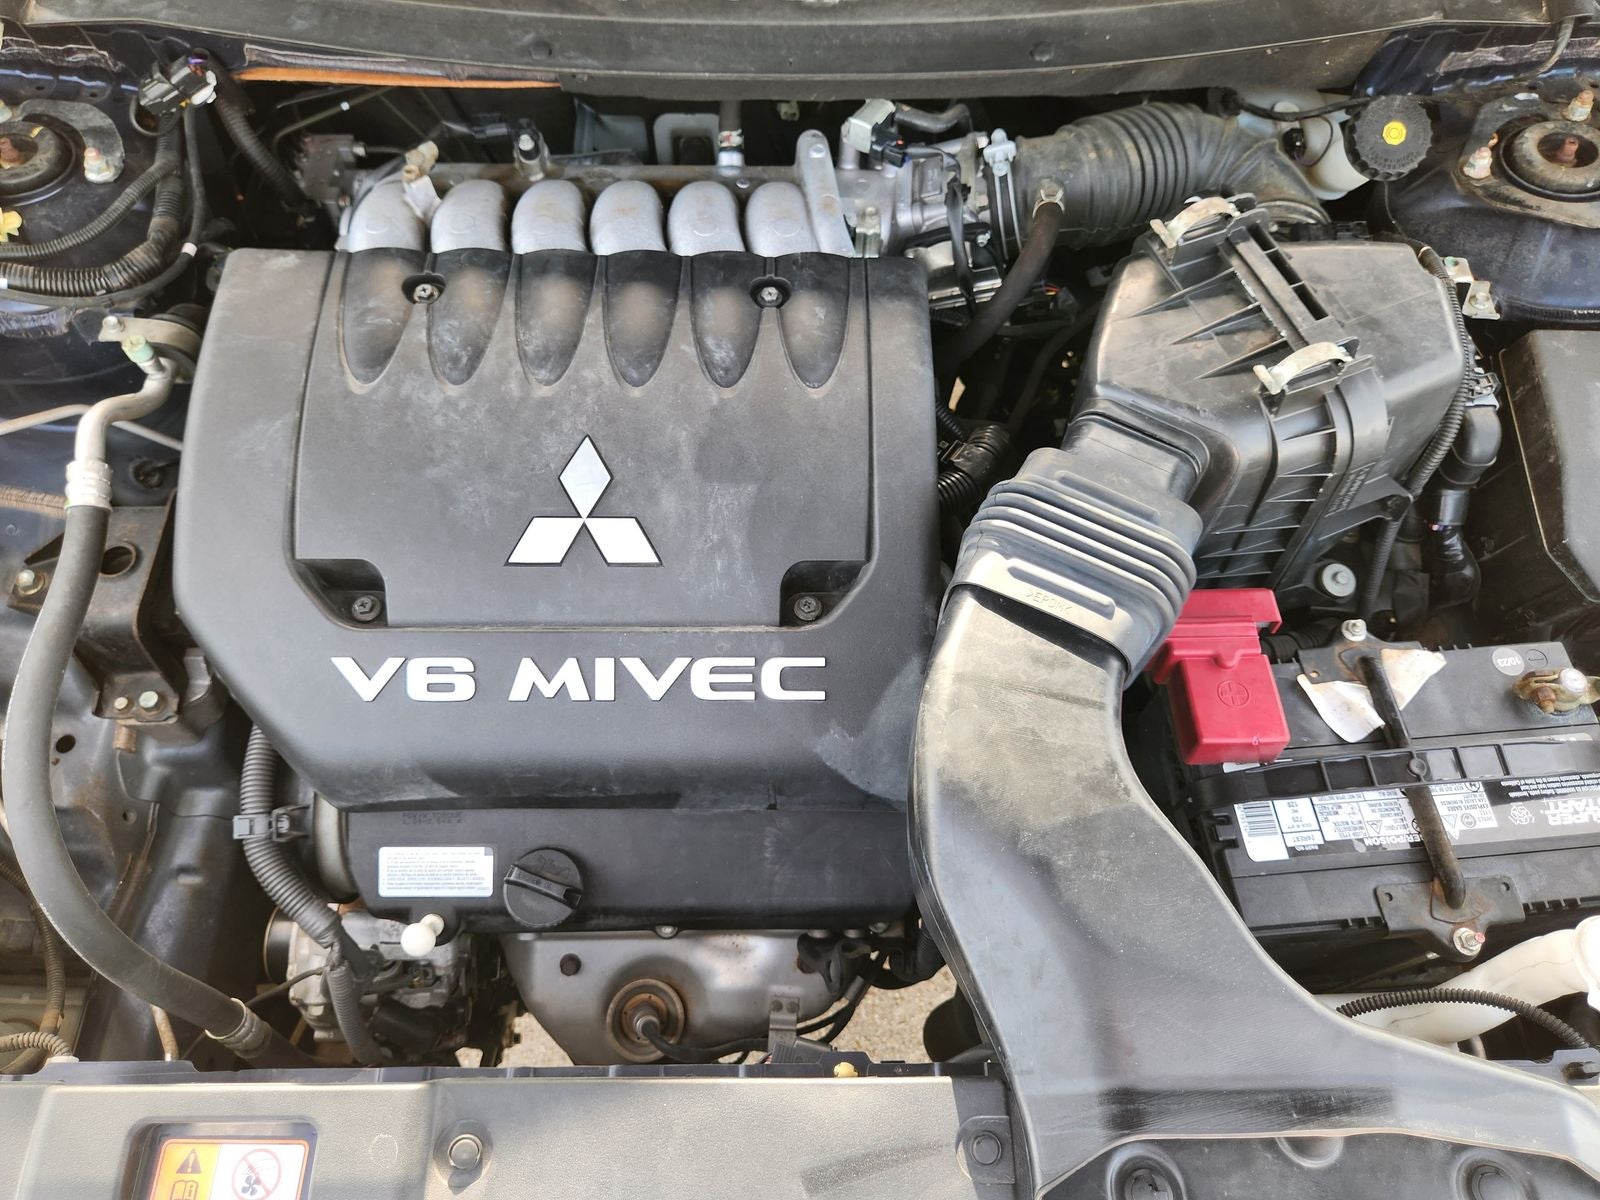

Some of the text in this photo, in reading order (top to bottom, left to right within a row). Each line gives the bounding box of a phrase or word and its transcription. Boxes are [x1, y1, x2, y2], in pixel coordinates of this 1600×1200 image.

[331, 656, 826, 702] V6 MIVEC
[1545, 798, 1600, 815] TART
[1547, 812, 1600, 826] UPER
[1363, 834, 1423, 847] ER/POISON
